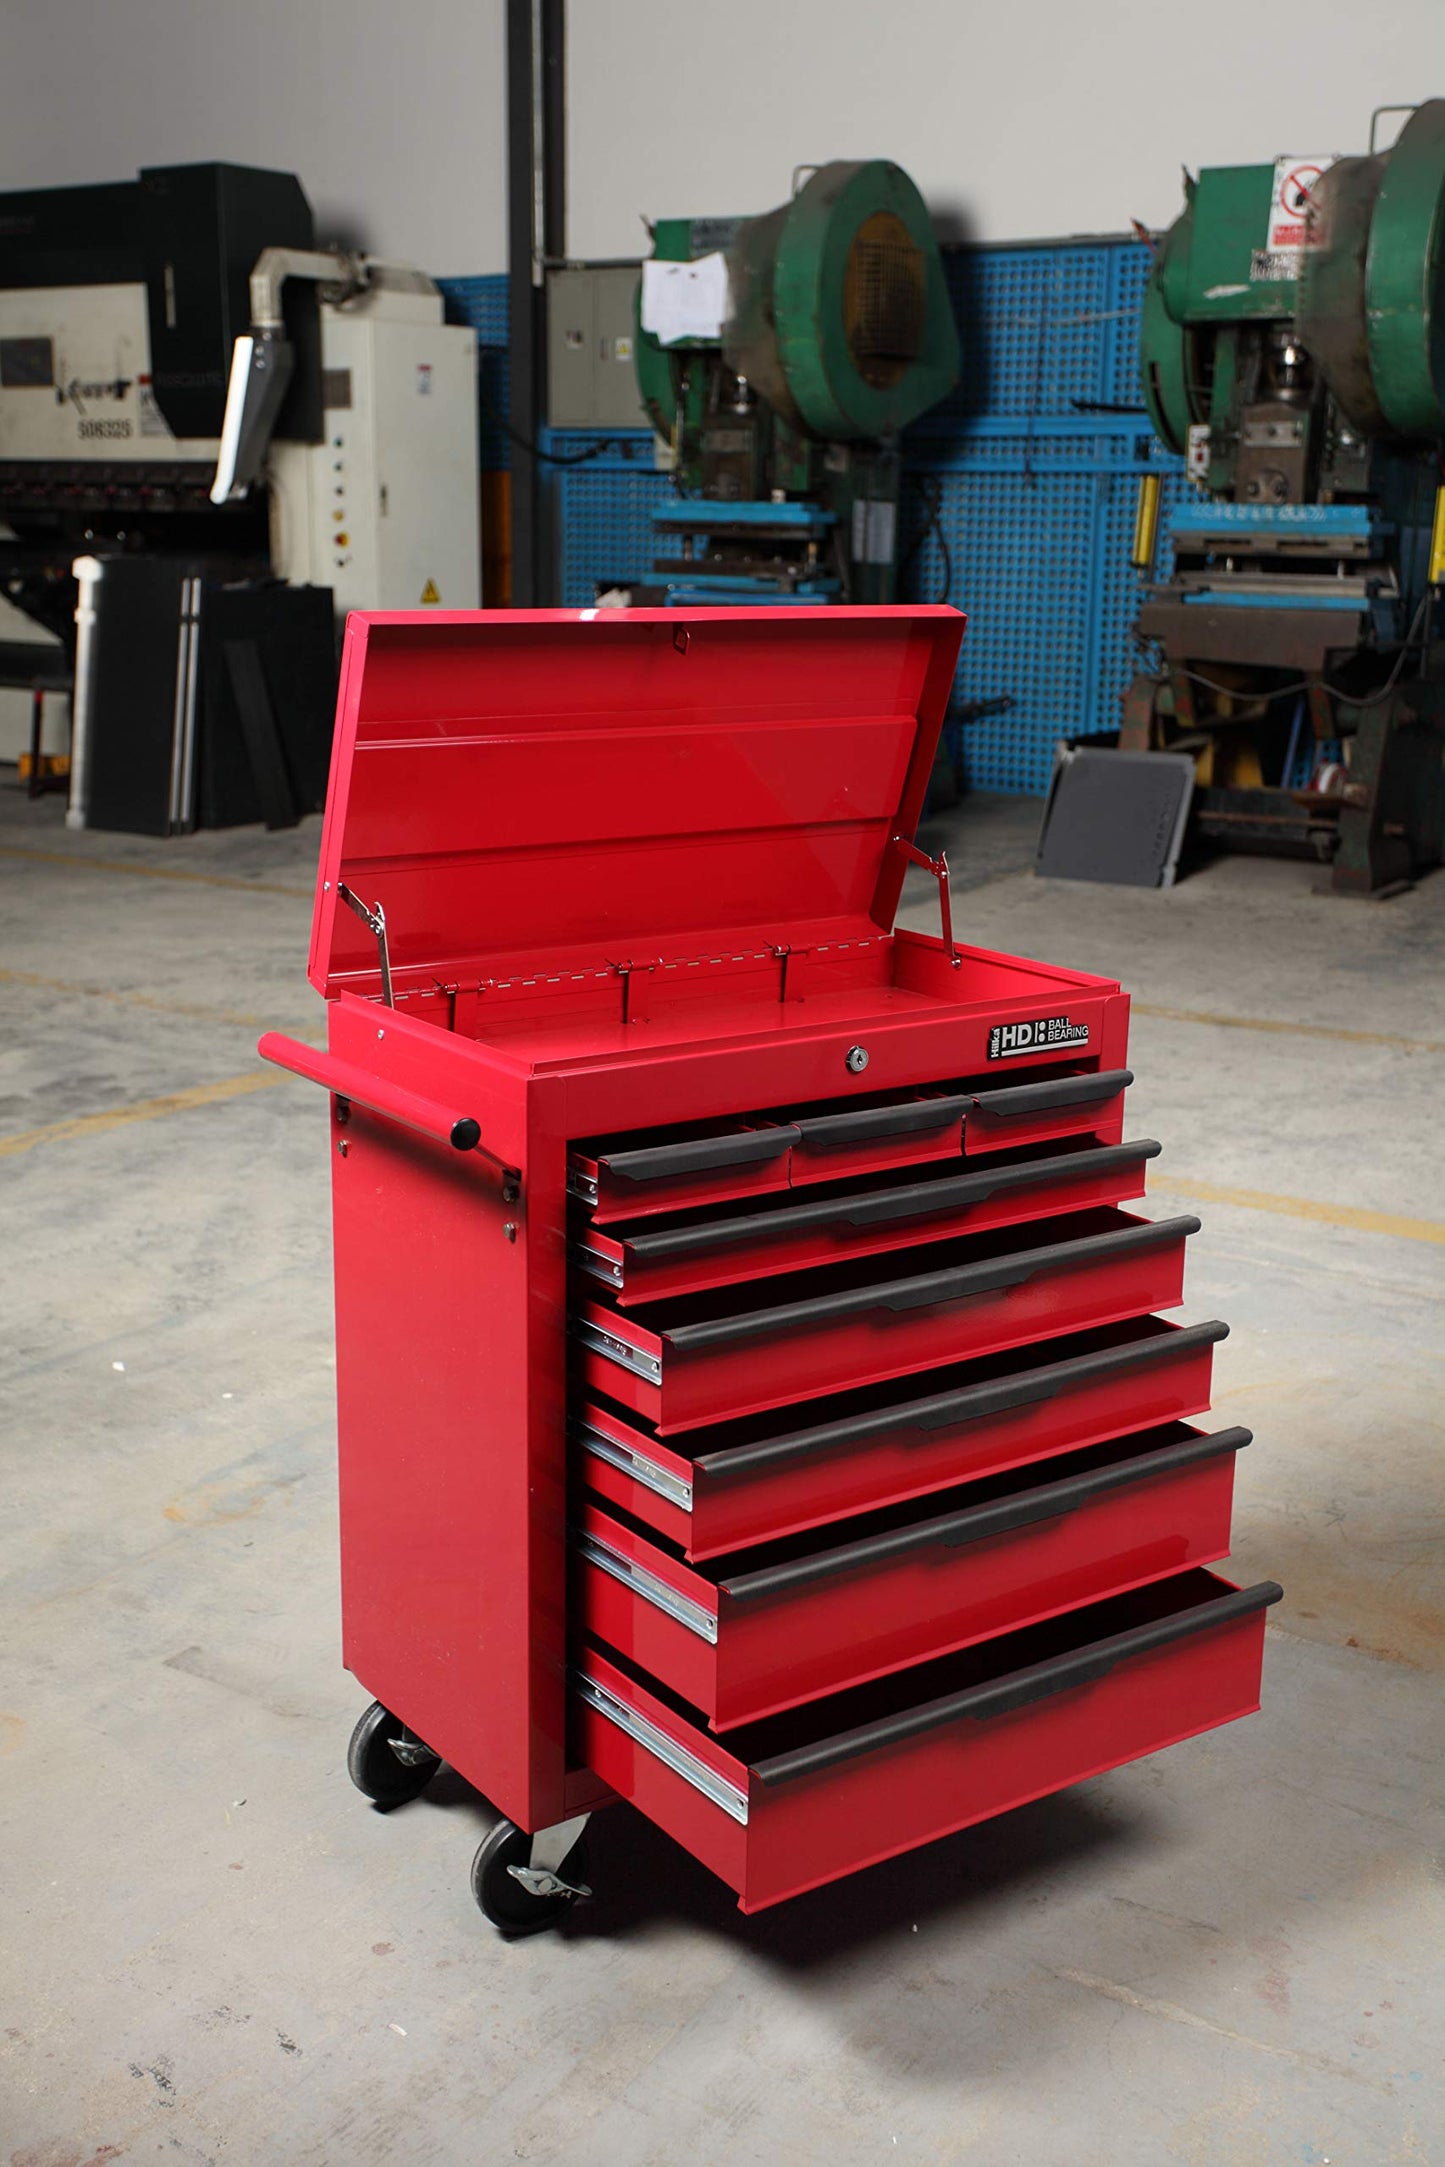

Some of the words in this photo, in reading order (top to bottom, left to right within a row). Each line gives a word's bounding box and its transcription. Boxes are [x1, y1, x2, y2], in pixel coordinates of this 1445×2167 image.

[1047, 1025, 1089, 1041] BEARING
[1048, 1018, 1072, 1030] BALL
[991, 1028, 1001, 1058] Hilka
[1001, 1024, 1032, 1048] HD
